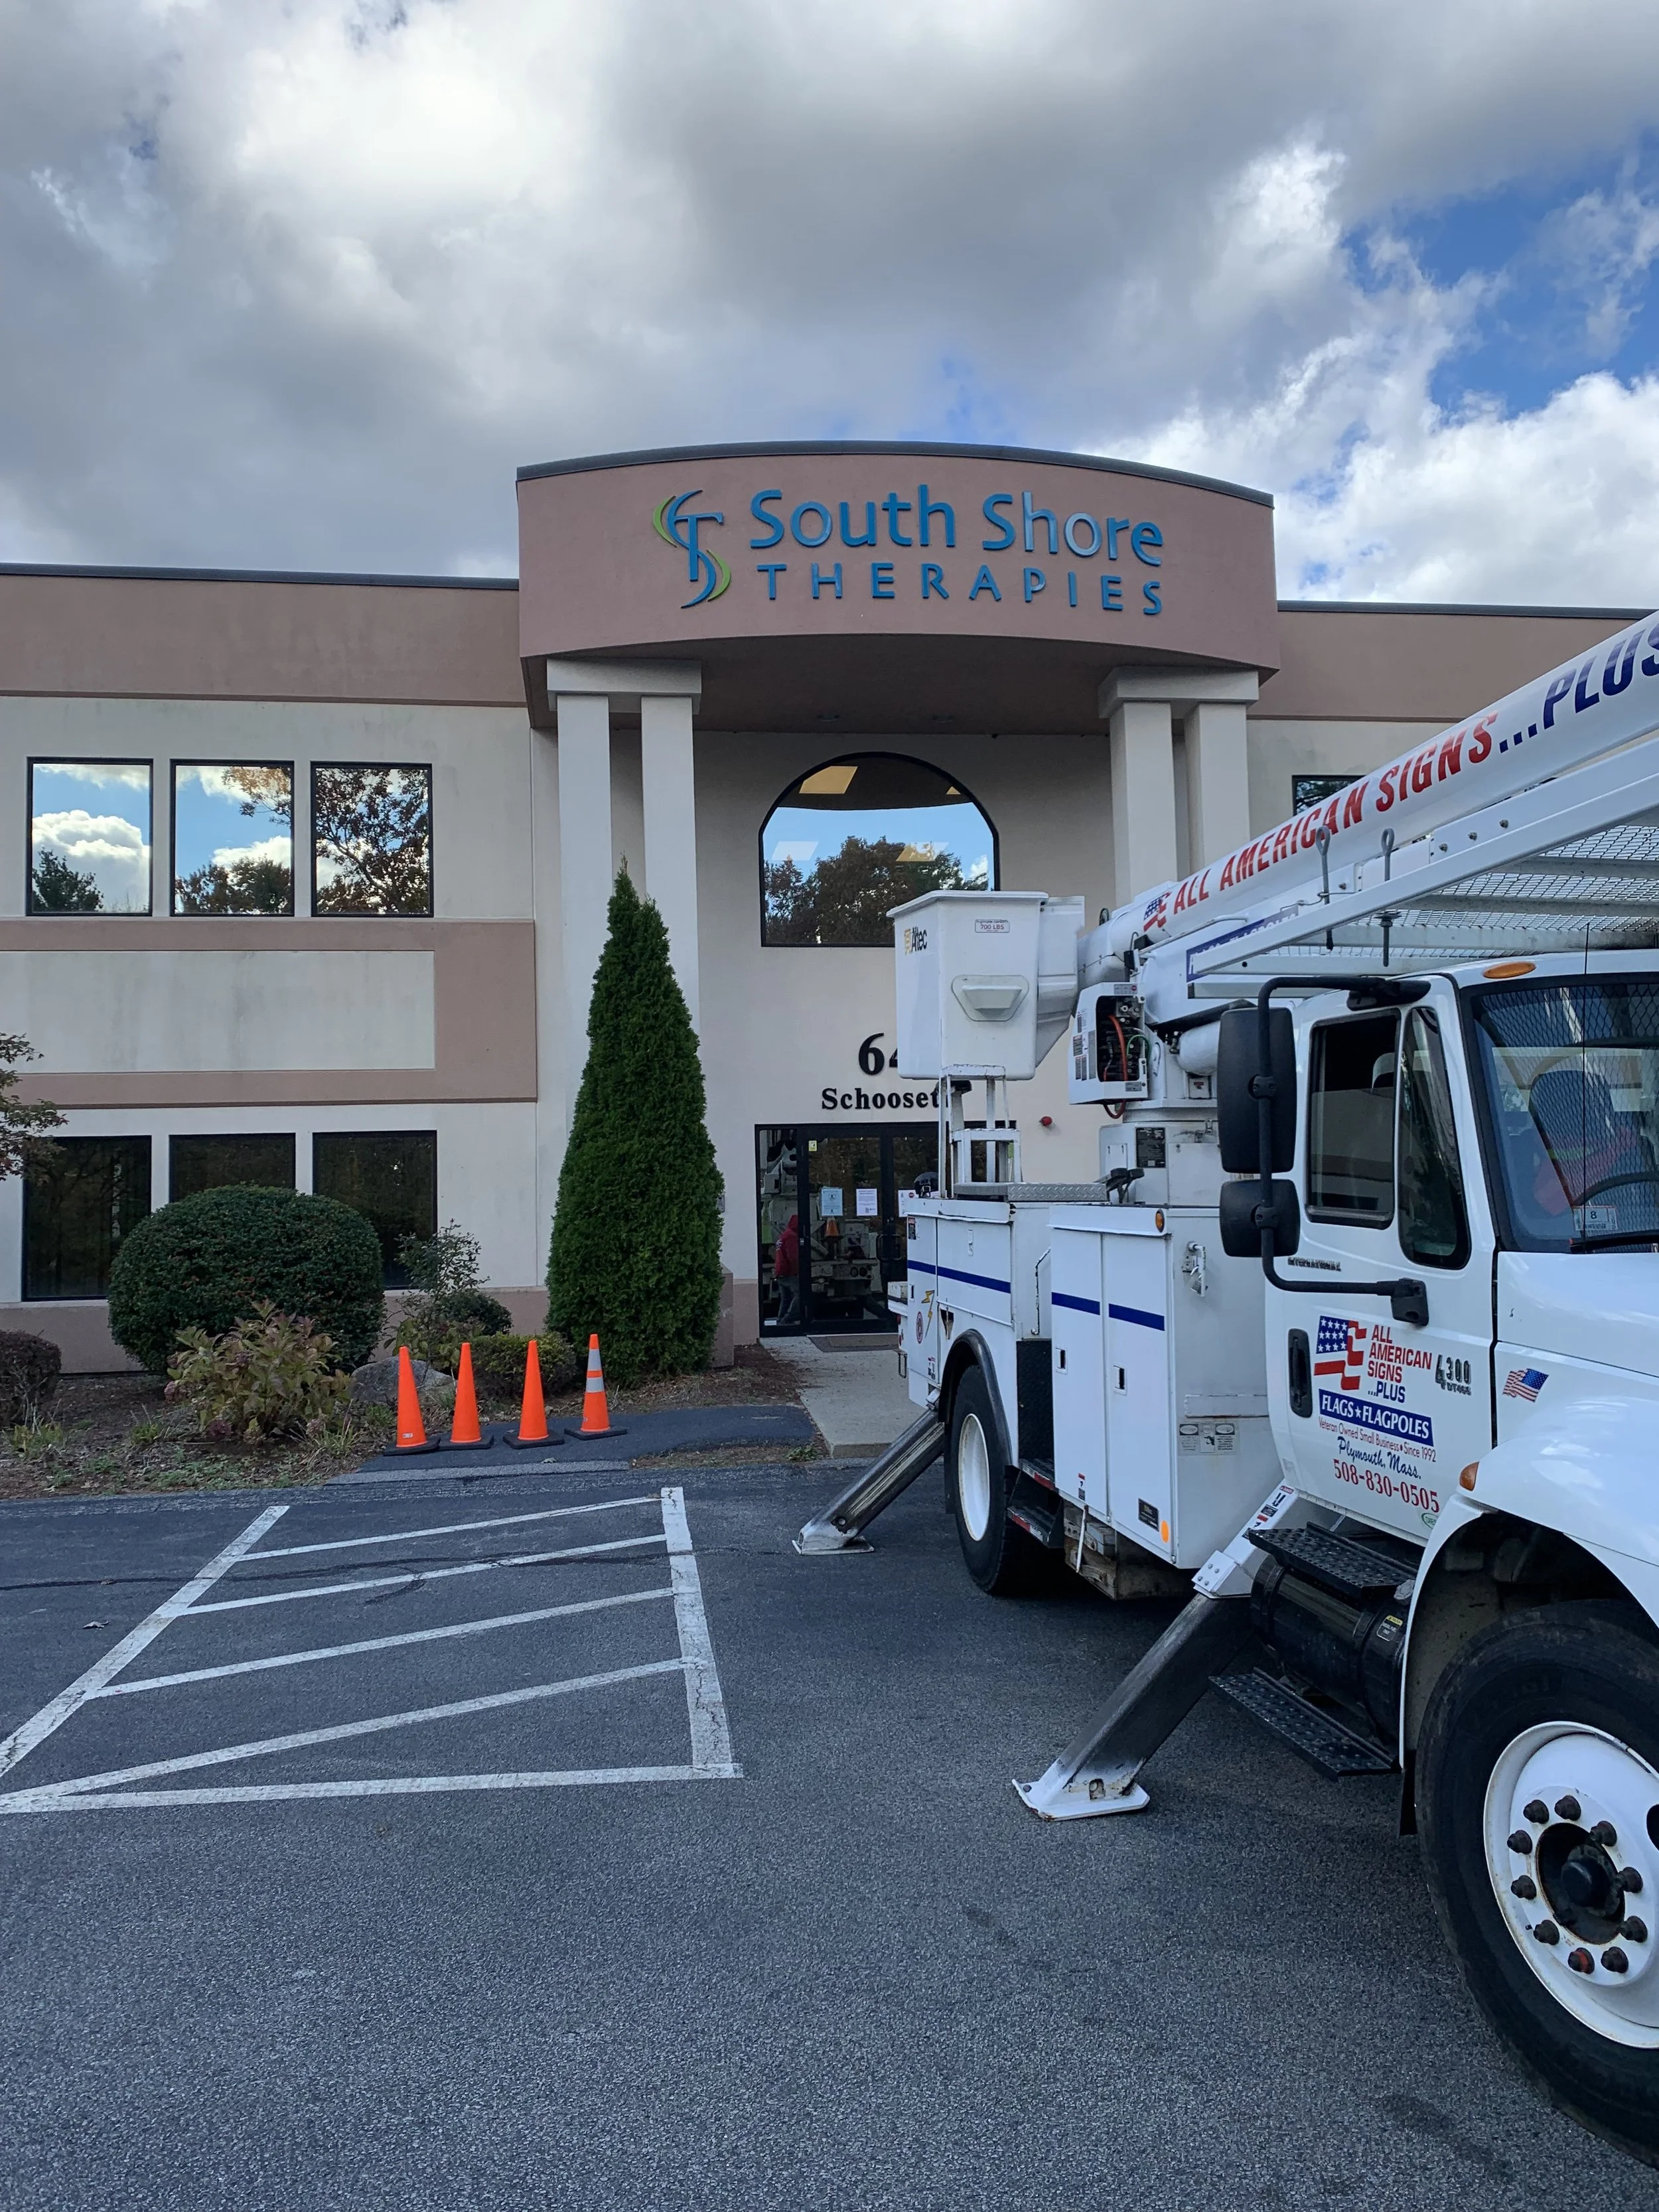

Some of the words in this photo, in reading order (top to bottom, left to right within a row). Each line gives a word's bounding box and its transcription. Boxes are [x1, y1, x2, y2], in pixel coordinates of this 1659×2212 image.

[750, 484, 956, 548] South
[982, 490, 1164, 567] Shore
[757, 561, 1163, 616] THERAPIES
[1173, 868, 1212, 915] ALL
[1220, 780, 1370, 892] AMERICAN
[911, 926, 928, 953] Altec
[1369, 1342, 1433, 1370] AMERICAN
[1371, 1324, 1393, 1344] ALL
[1367, 1360, 1403, 1384] SIGNS
[1435, 1354, 1472, 1390] 4300
[1321, 1394, 1354, 1418] FLAGS
[1362, 1404, 1429, 1439] FLAGPOLES
[1319, 1416, 1338, 1432] Veteran
[1338, 1422, 1359, 1439] Owned
[1360, 1428, 1375, 1444] Small
[1376, 1434, 1400, 1451] Business
[1404, 1441, 1420, 1458] Since
[1421, 1446, 1437, 1463] 1992
[1337, 1436, 1386, 1469] Plymouth,
[1386, 1451, 1421, 1480] Mass.
[1333, 1458, 1440, 1513] 508-830-0505
